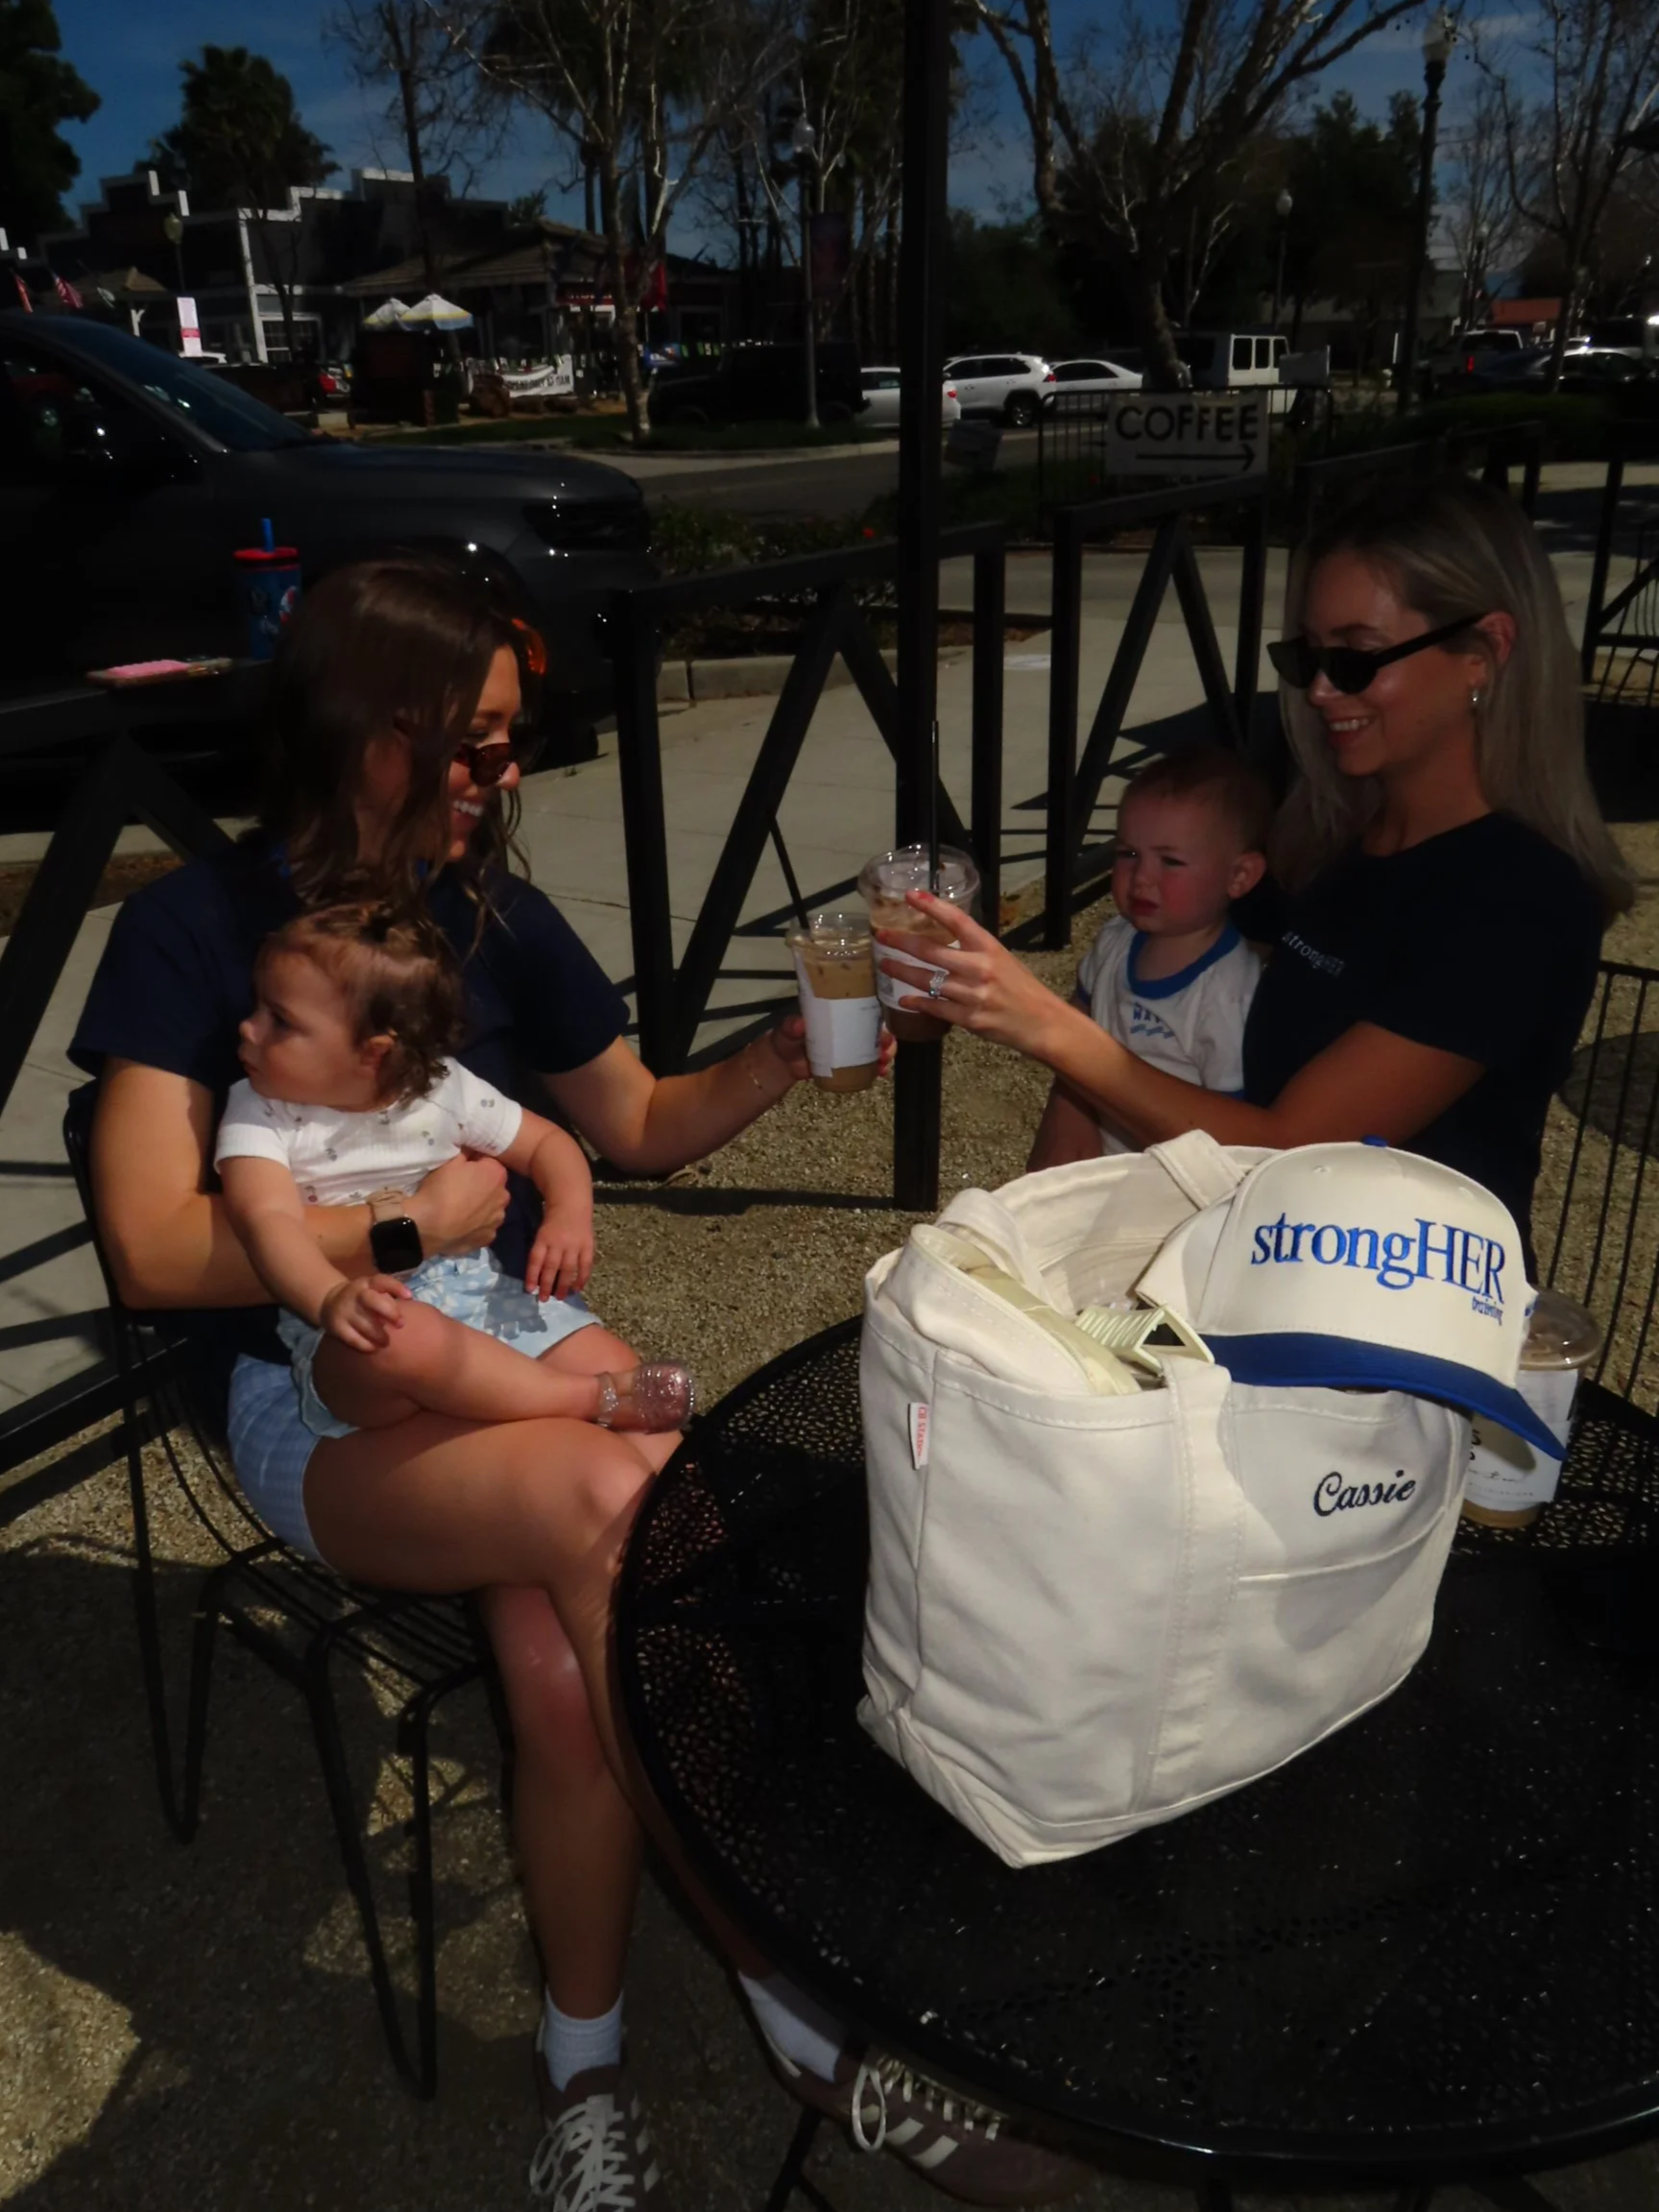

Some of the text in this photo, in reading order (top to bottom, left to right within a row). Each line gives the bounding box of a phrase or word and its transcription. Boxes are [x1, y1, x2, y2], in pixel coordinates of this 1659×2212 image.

[1116, 405, 1258, 441] COFFEE
[1251, 1213, 1505, 1304] strongHER
[1313, 1470, 1416, 1516] Cassie
